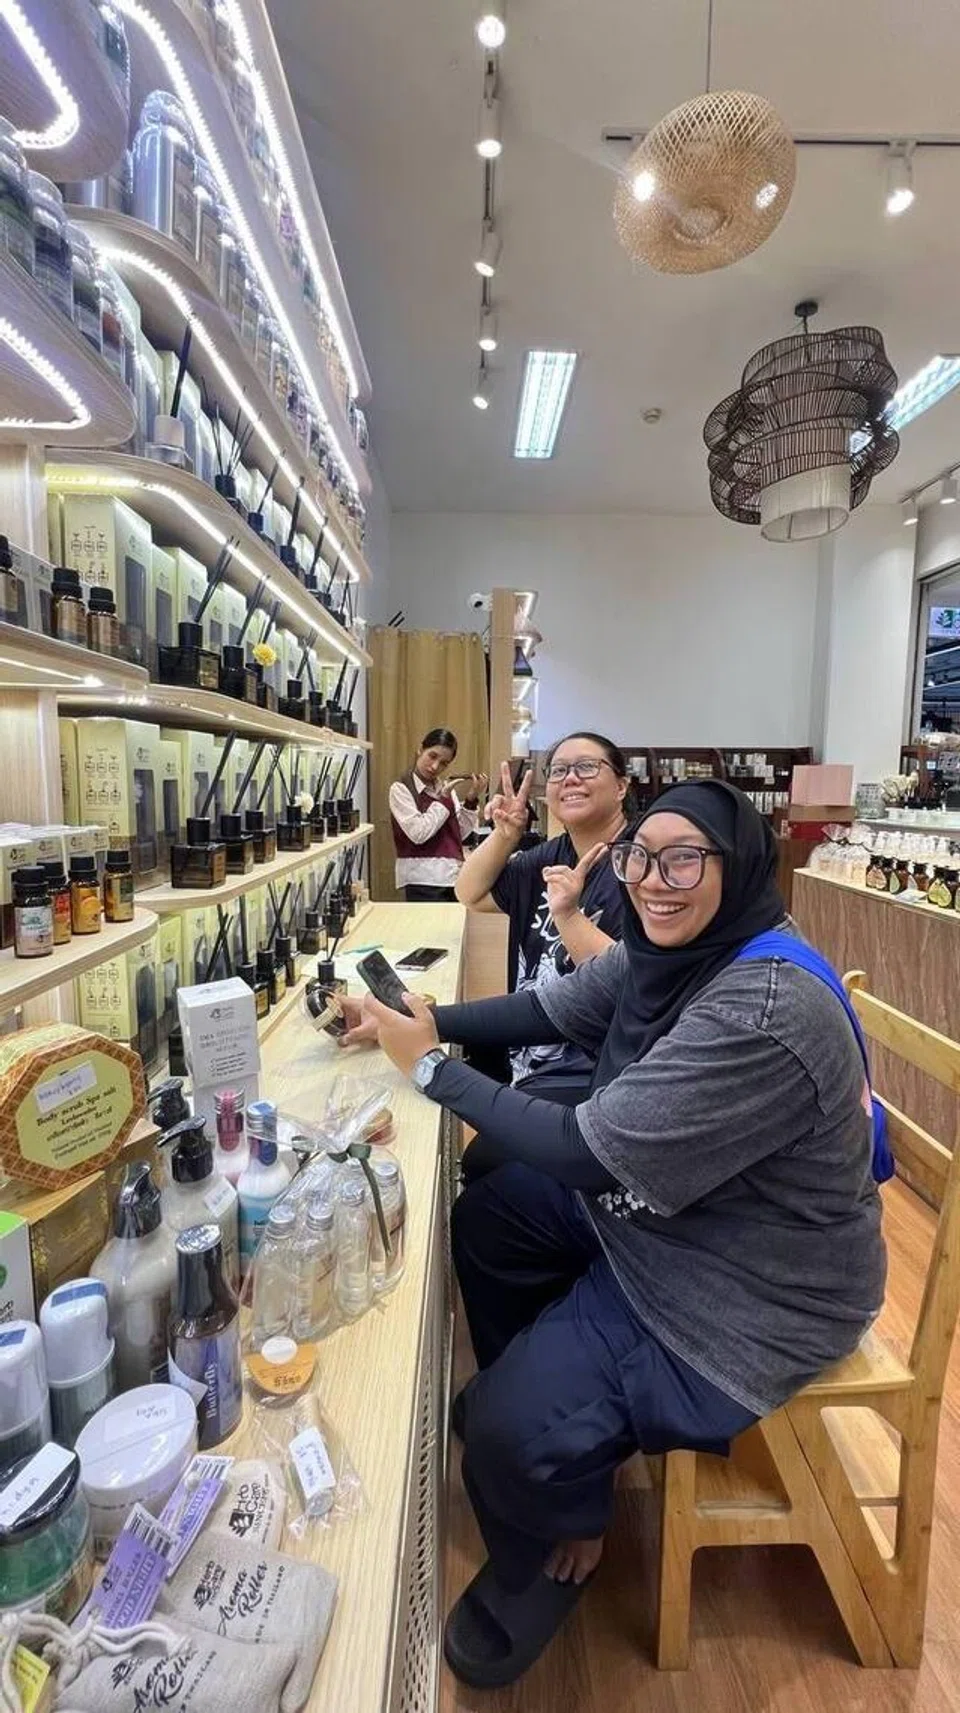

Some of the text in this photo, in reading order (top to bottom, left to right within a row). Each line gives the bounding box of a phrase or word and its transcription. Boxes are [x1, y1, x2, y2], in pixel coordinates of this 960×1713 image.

[204, 1363, 218, 1419] Butterfly
[217, 1569, 247, 1636] Aroma
[238, 1561, 268, 1617] Roller
